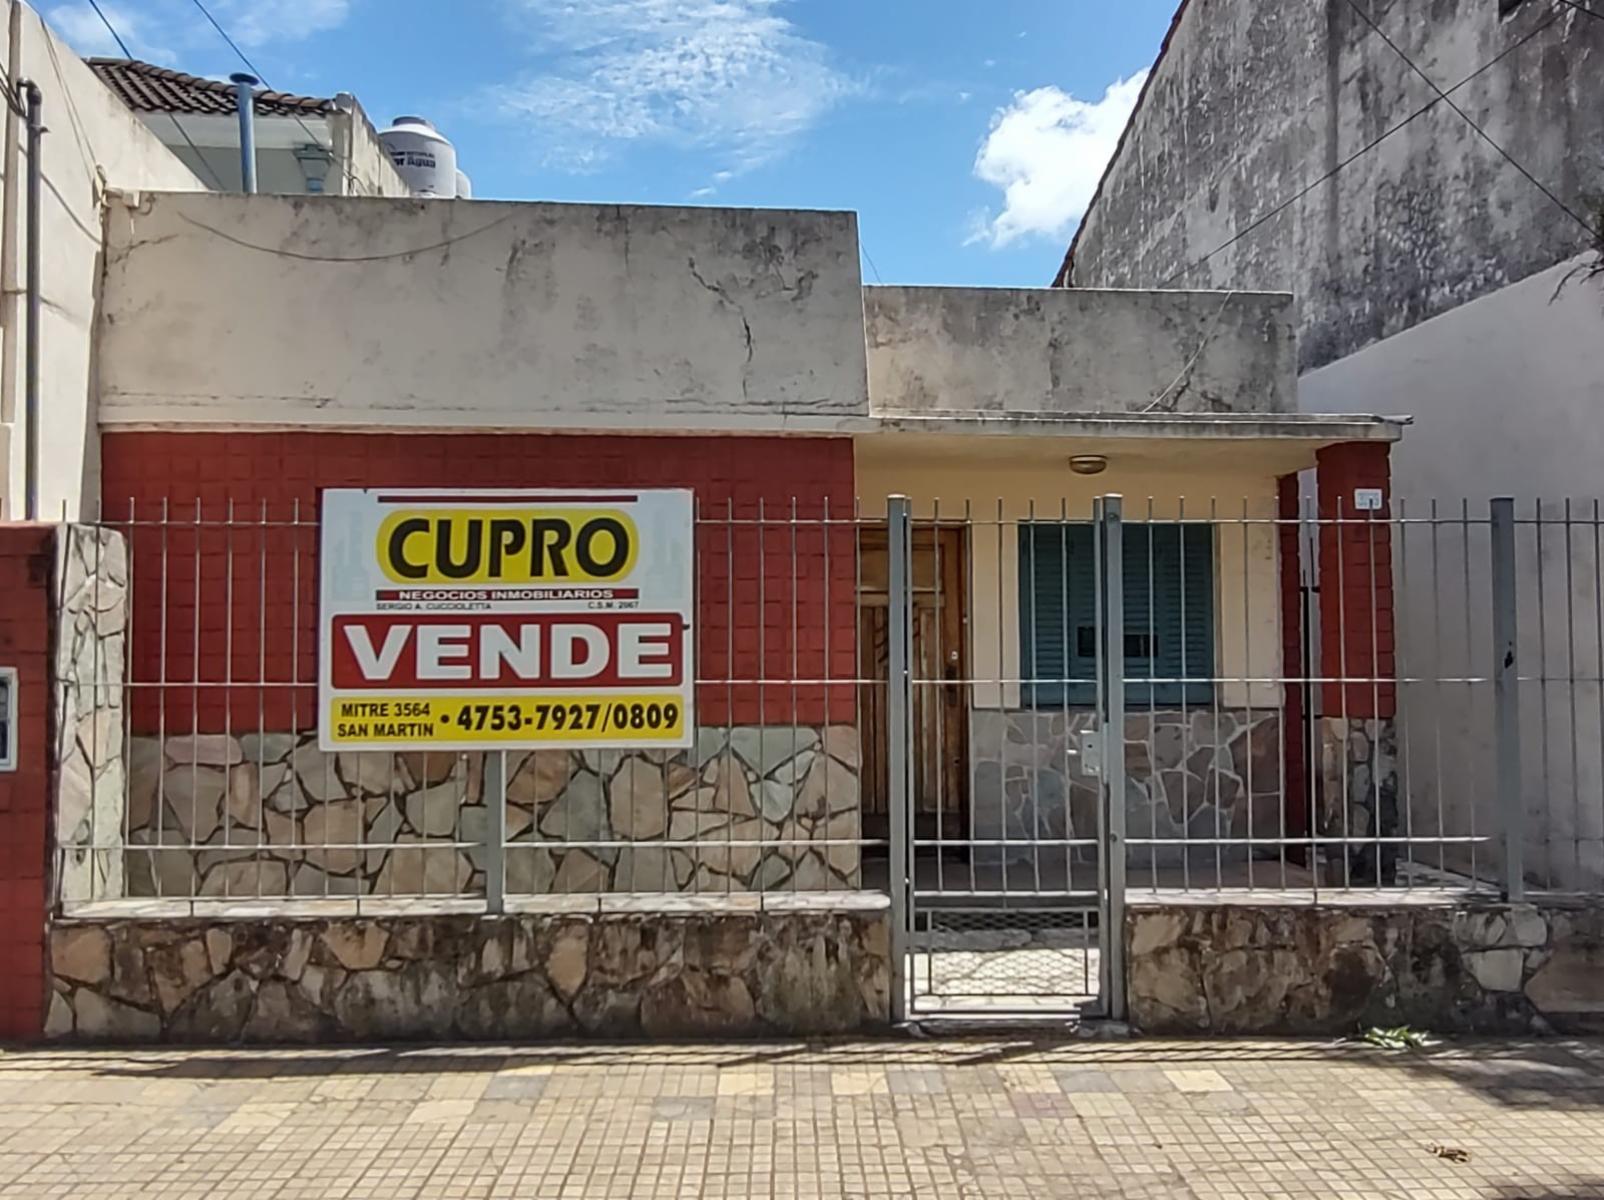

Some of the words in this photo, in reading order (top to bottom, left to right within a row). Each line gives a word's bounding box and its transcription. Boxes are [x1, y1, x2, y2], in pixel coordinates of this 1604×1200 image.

[388, 517, 630, 579] CUPRO
[399, 590, 488, 600] NEGOCIOS
[491, 589, 614, 600] INMOBILIARIOS
[376, 602, 412, 610] SERGIO
[343, 623, 673, 680] VENDE
[341, 703, 389, 717] MITRE
[394, 702, 430, 717] 3564
[456, 703, 679, 732] 4753-7927/0809
[337, 723, 368, 737] SAN
[373, 723, 434, 737] MARTIN
